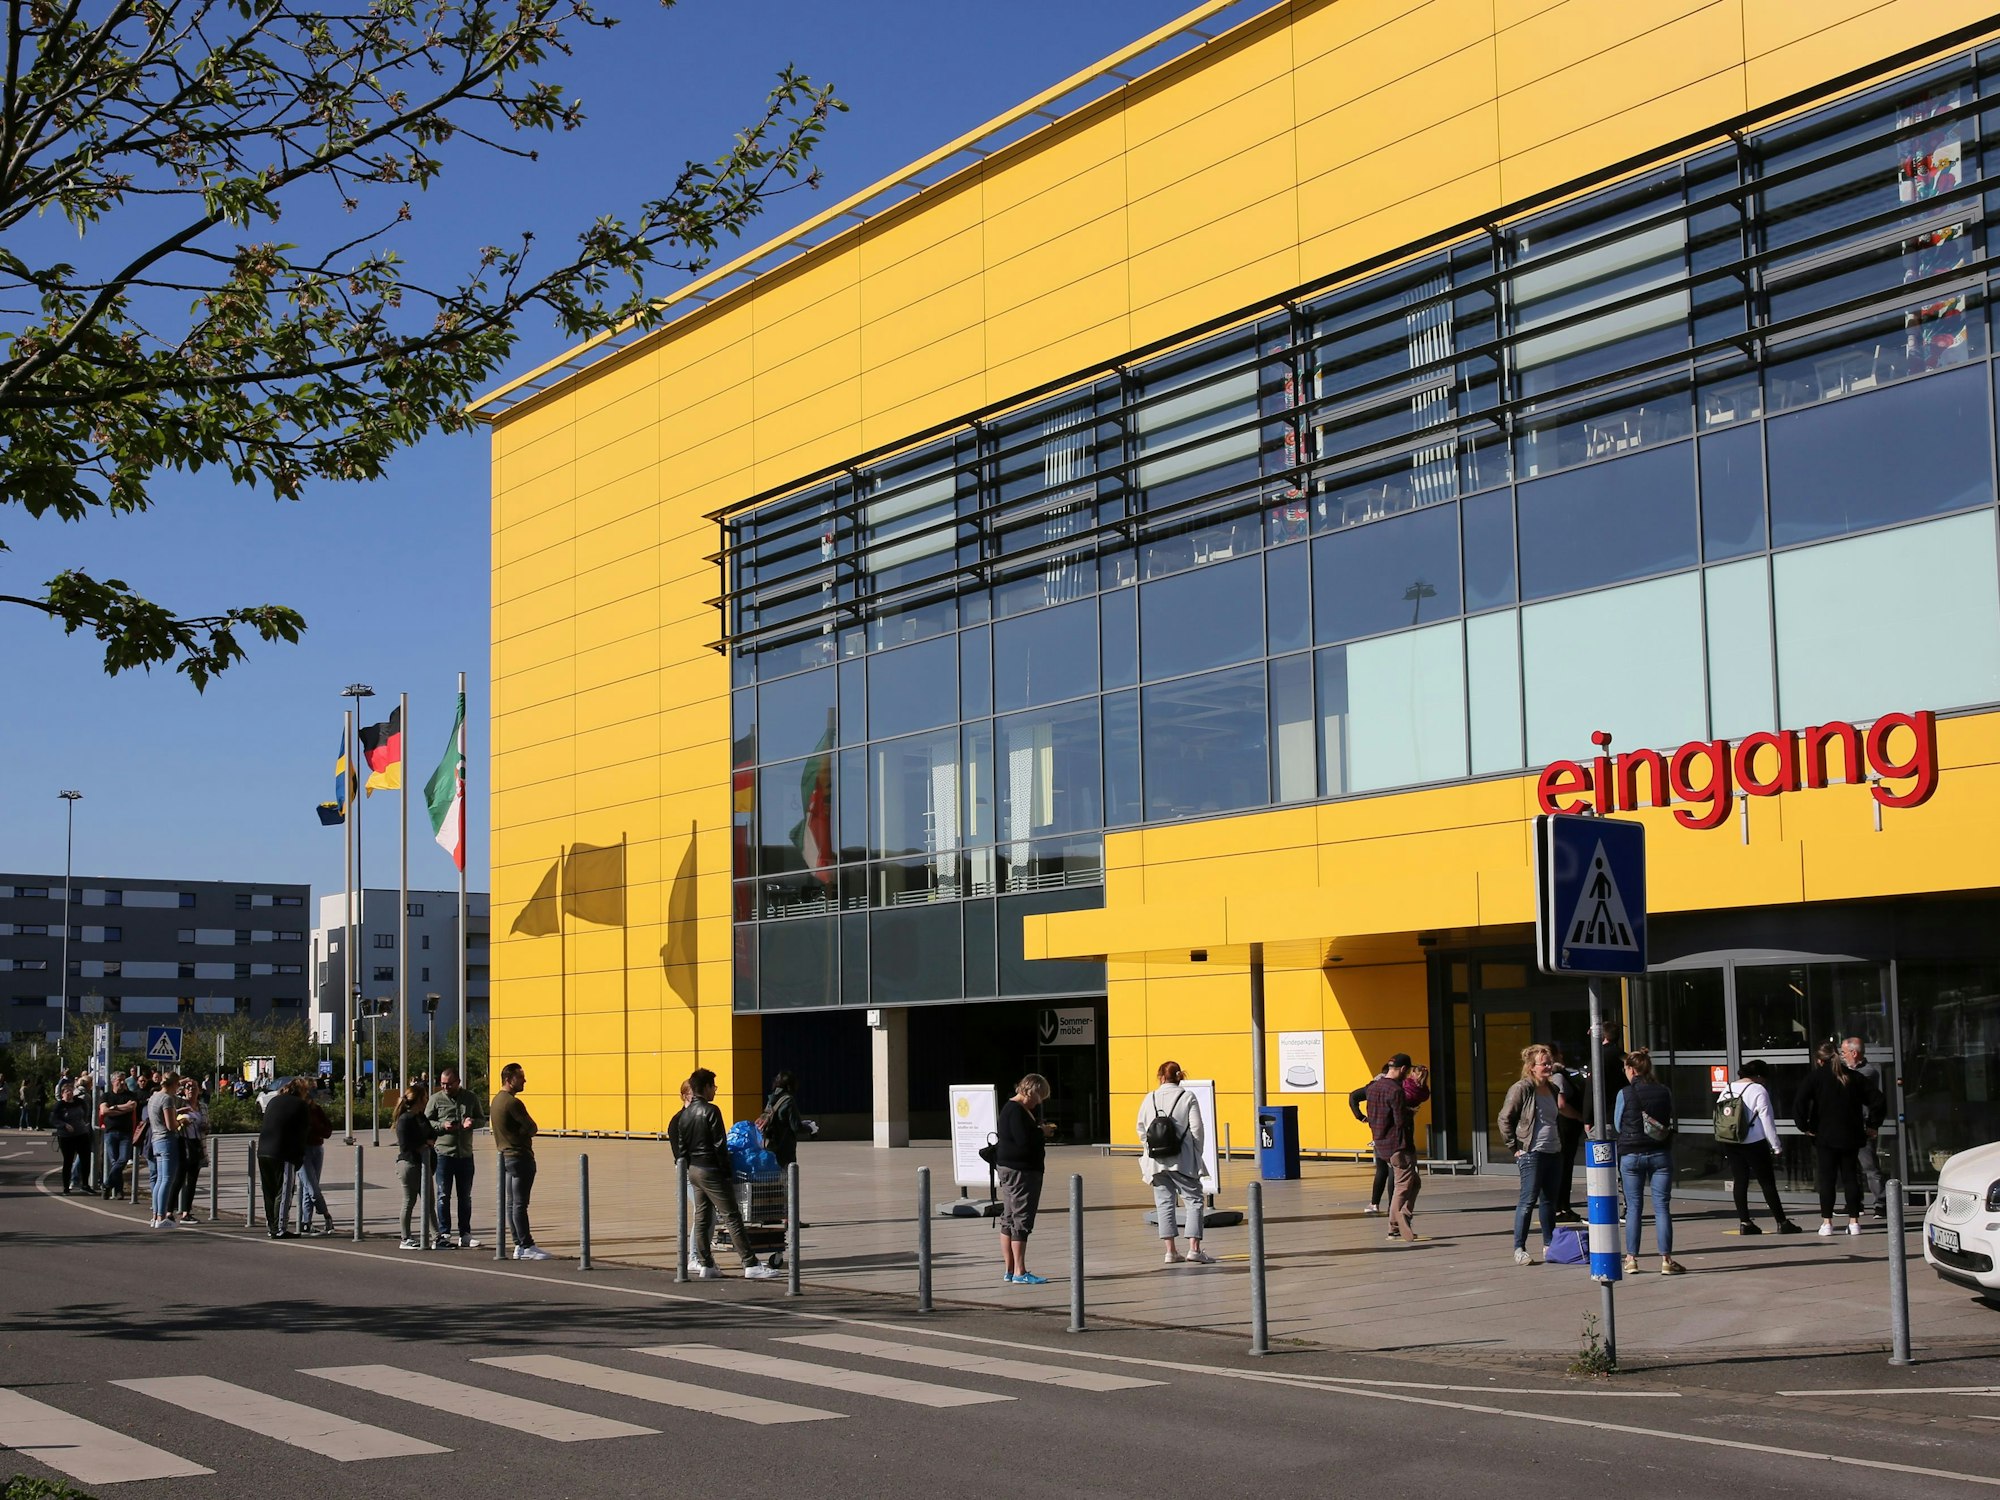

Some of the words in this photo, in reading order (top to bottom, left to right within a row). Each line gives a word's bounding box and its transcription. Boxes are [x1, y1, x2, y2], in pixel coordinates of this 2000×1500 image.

[1538, 711, 1936, 829] eingang
[1060, 1017, 1092, 1026] Sommer-
[1060, 1025, 1083, 1035] möbel
